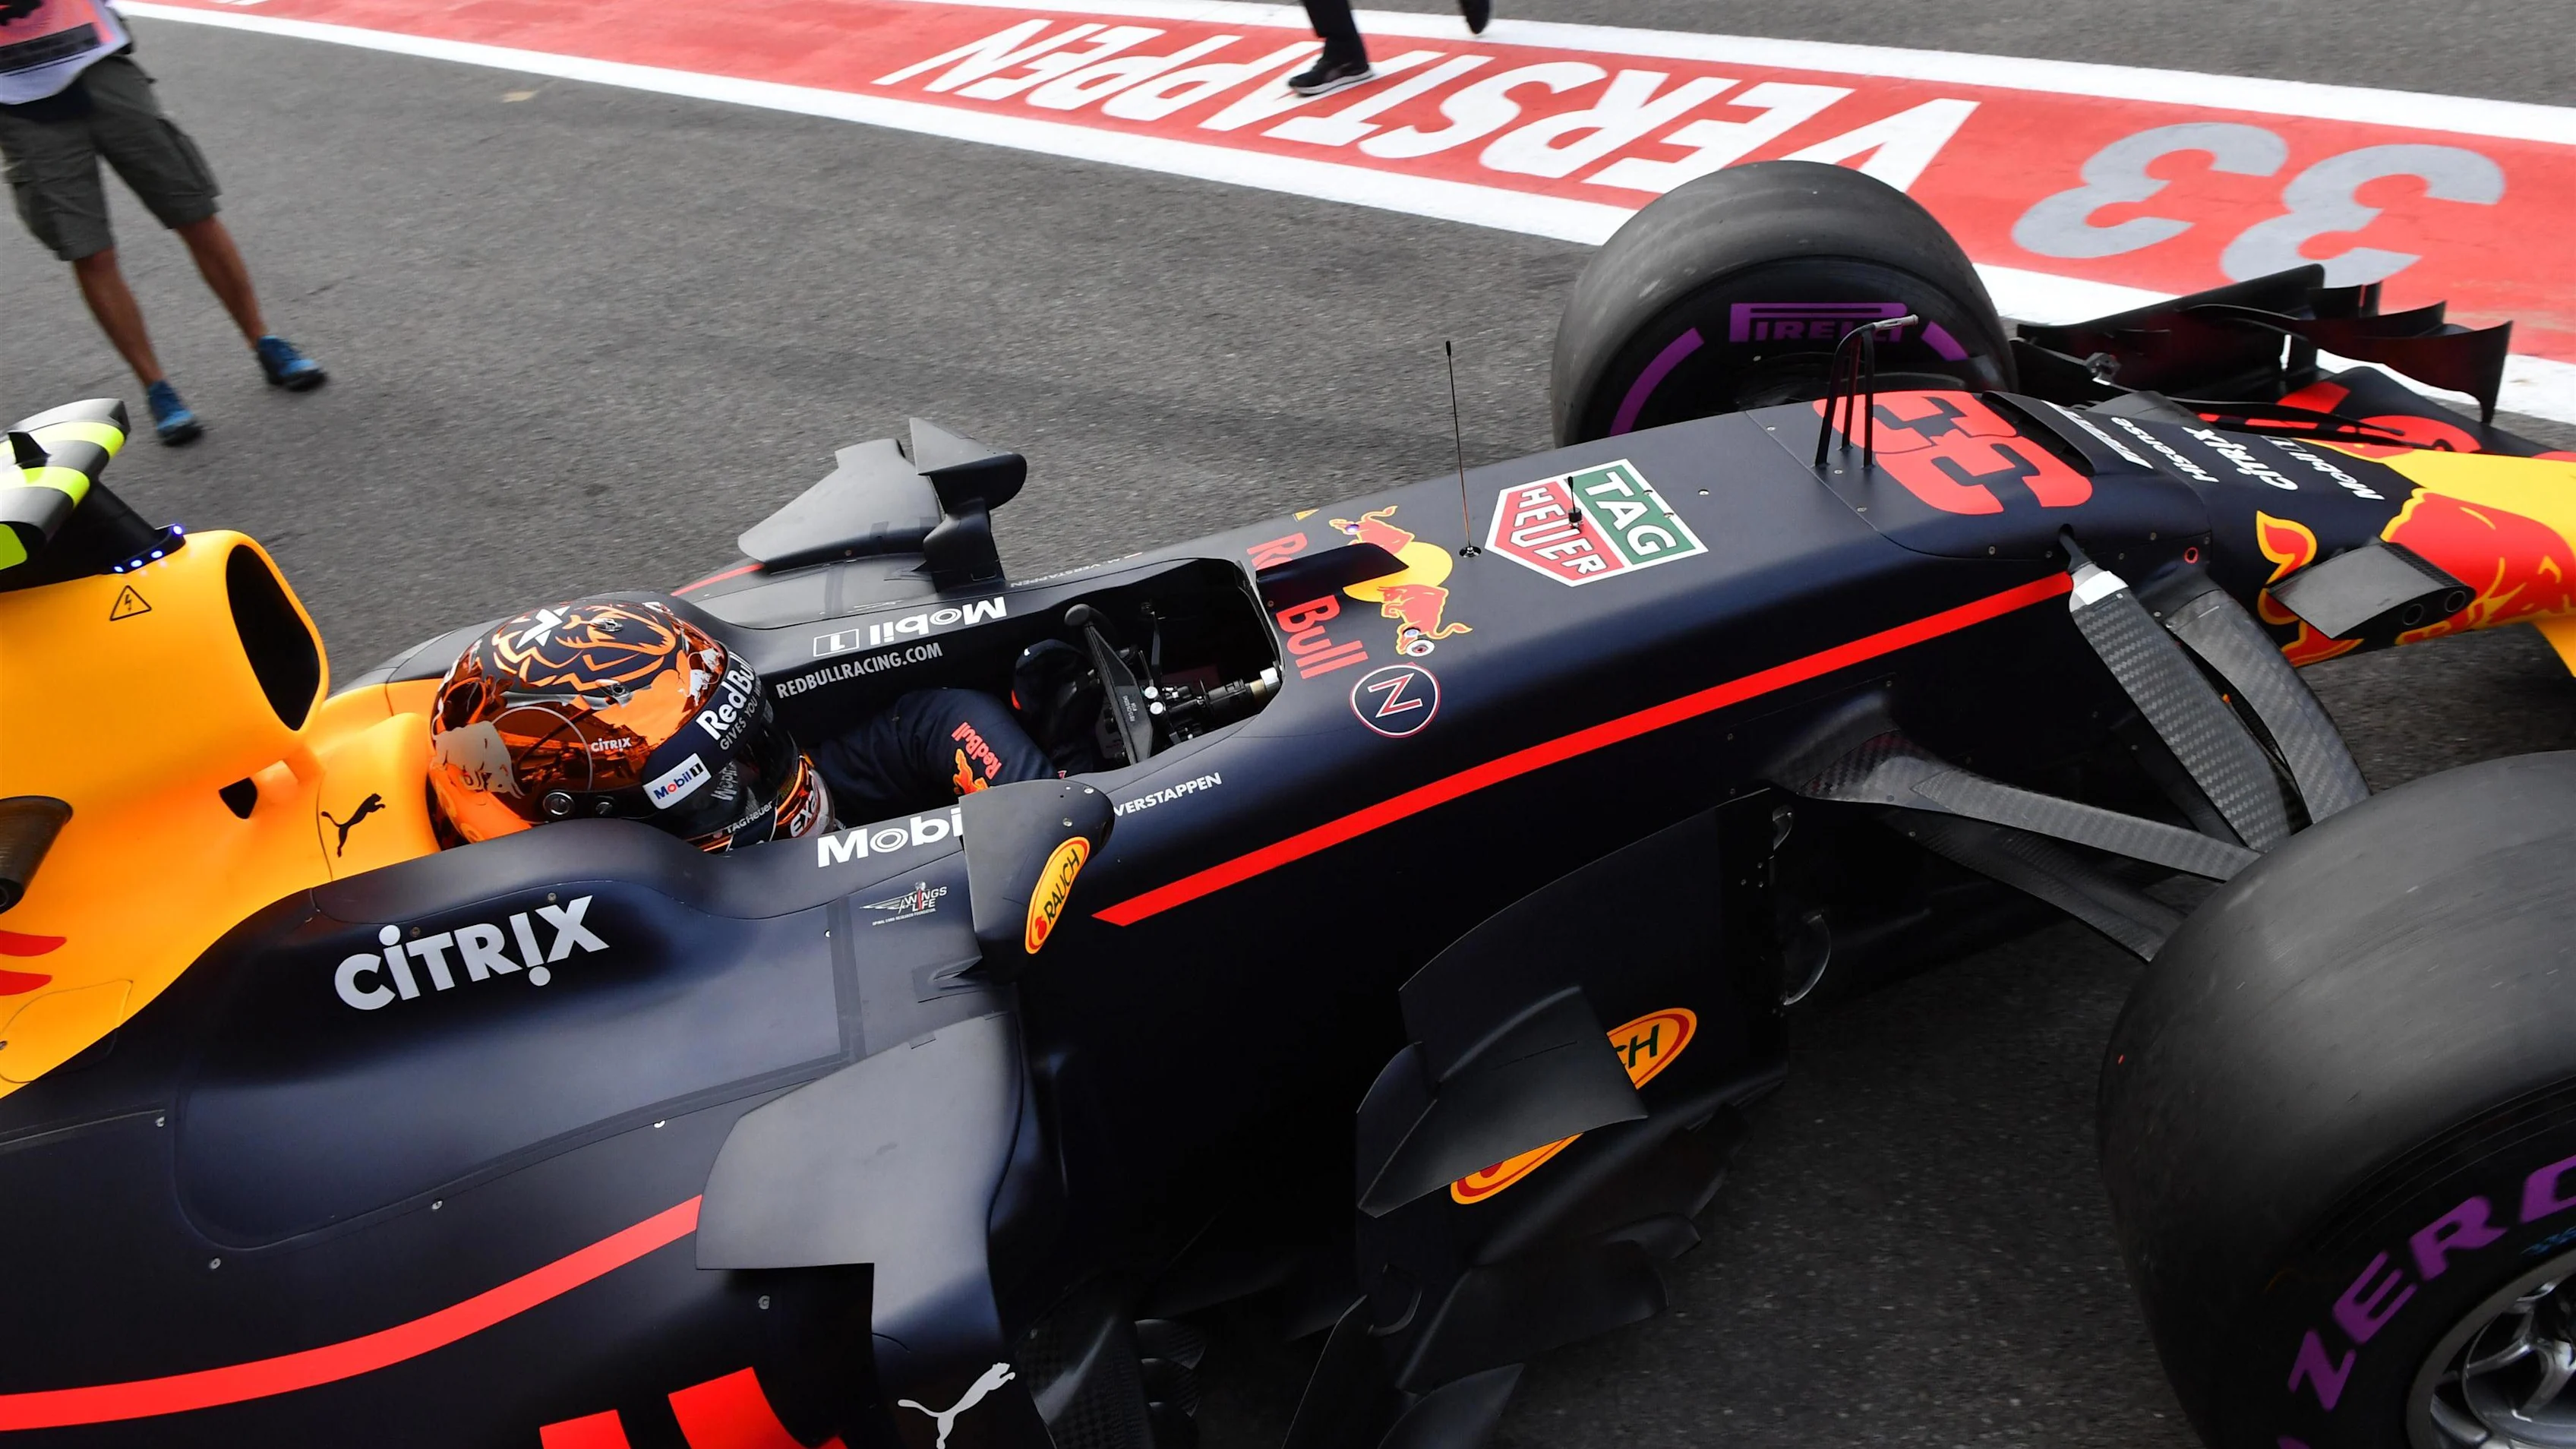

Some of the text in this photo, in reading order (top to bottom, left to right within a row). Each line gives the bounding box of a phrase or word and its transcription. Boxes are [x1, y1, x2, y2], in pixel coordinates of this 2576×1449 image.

[871, 19, 1979, 192] VERSTAPPEN
[2011, 122, 2505, 288] 33
[1812, 390, 2093, 515] 33
[2110, 416, 2219, 484] Hisense
[2288, 452, 2385, 500] Mobil
[1509, 487, 1608, 574] HEUER
[1585, 471, 1677, 556] TAG
[870, 596, 1007, 646] Mobil
[1275, 595, 1368, 679] Bull
[776, 642, 942, 699] REDBULLRACING.COM
[721, 717, 747, 750] GIVES
[653, 771, 693, 800] Mobil
[1113, 772, 1223, 817] VERSTAPPEN
[818, 807, 963, 868] Mobi
[1043, 848, 1080, 925] RAUCH
